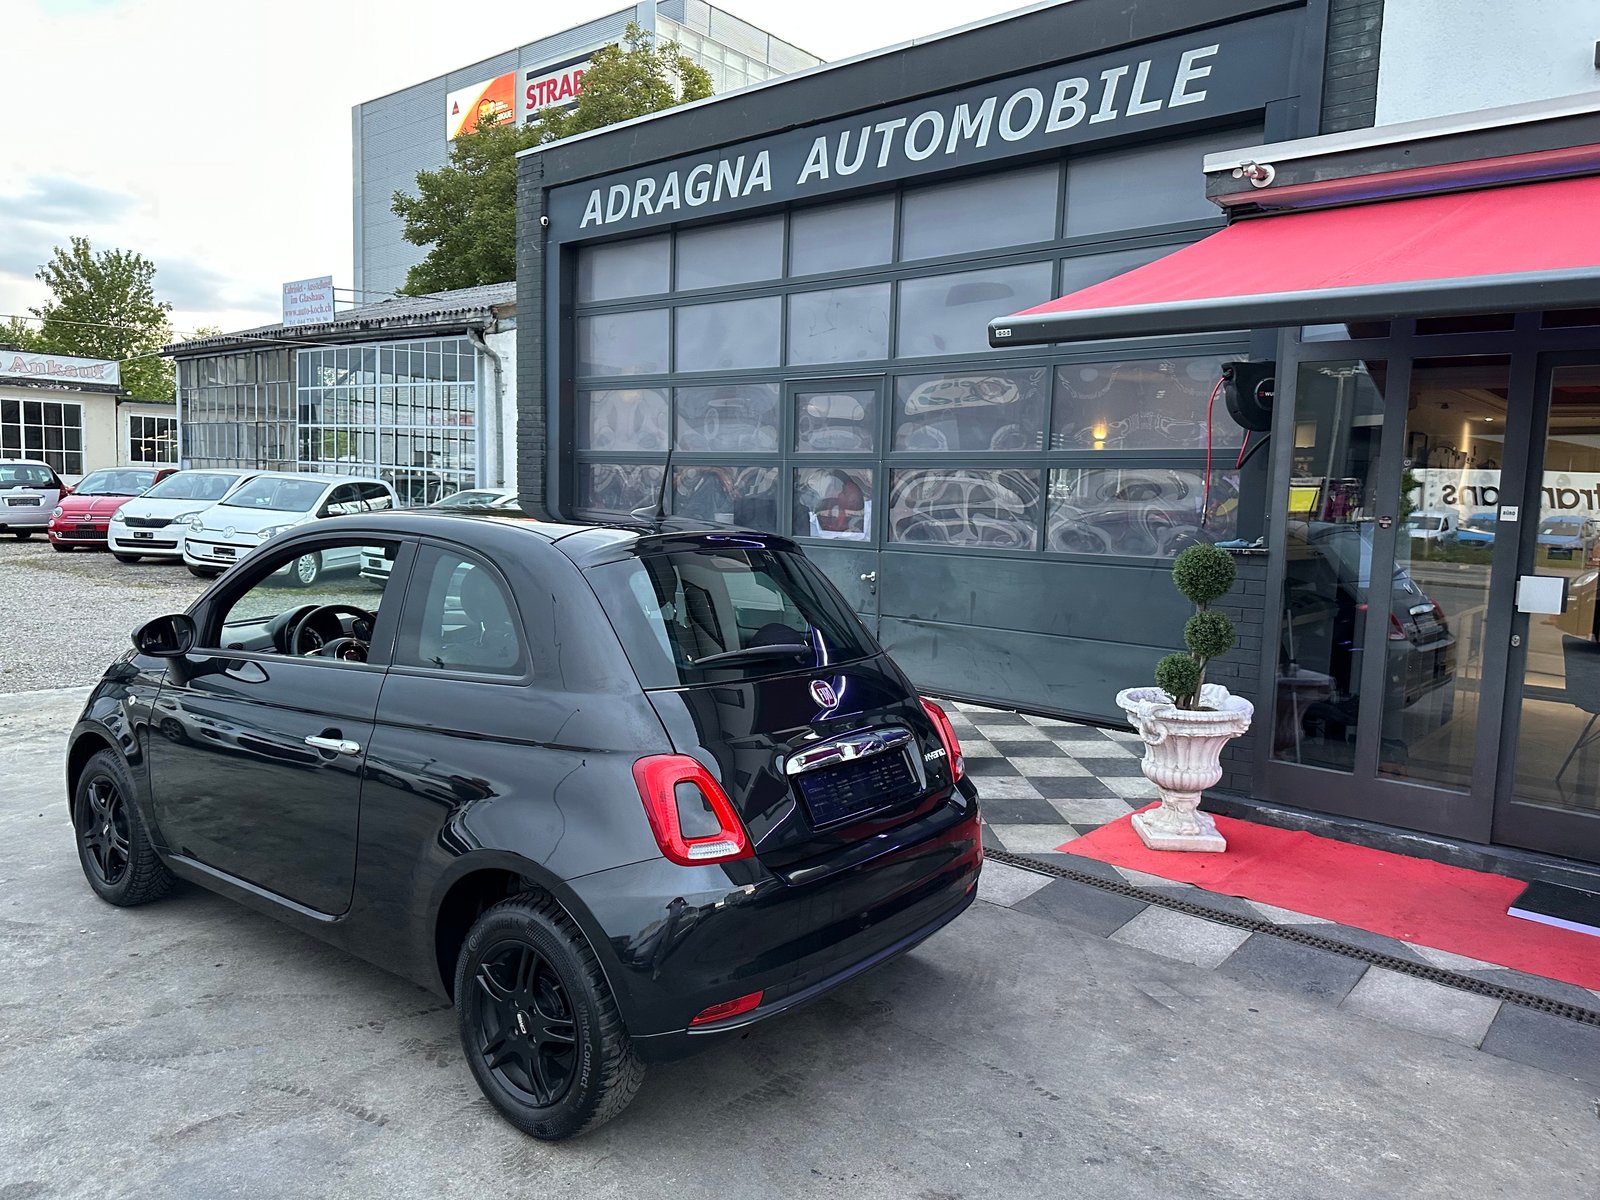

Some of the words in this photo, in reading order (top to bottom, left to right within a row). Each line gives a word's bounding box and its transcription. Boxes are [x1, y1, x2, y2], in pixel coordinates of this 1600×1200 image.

[526, 69, 587, 110] STRAB
[579, 149, 772, 229] ADRAGNA
[796, 44, 1220, 185] AUTOMOBILE
[8, 355, 104, 379] Ankauf
